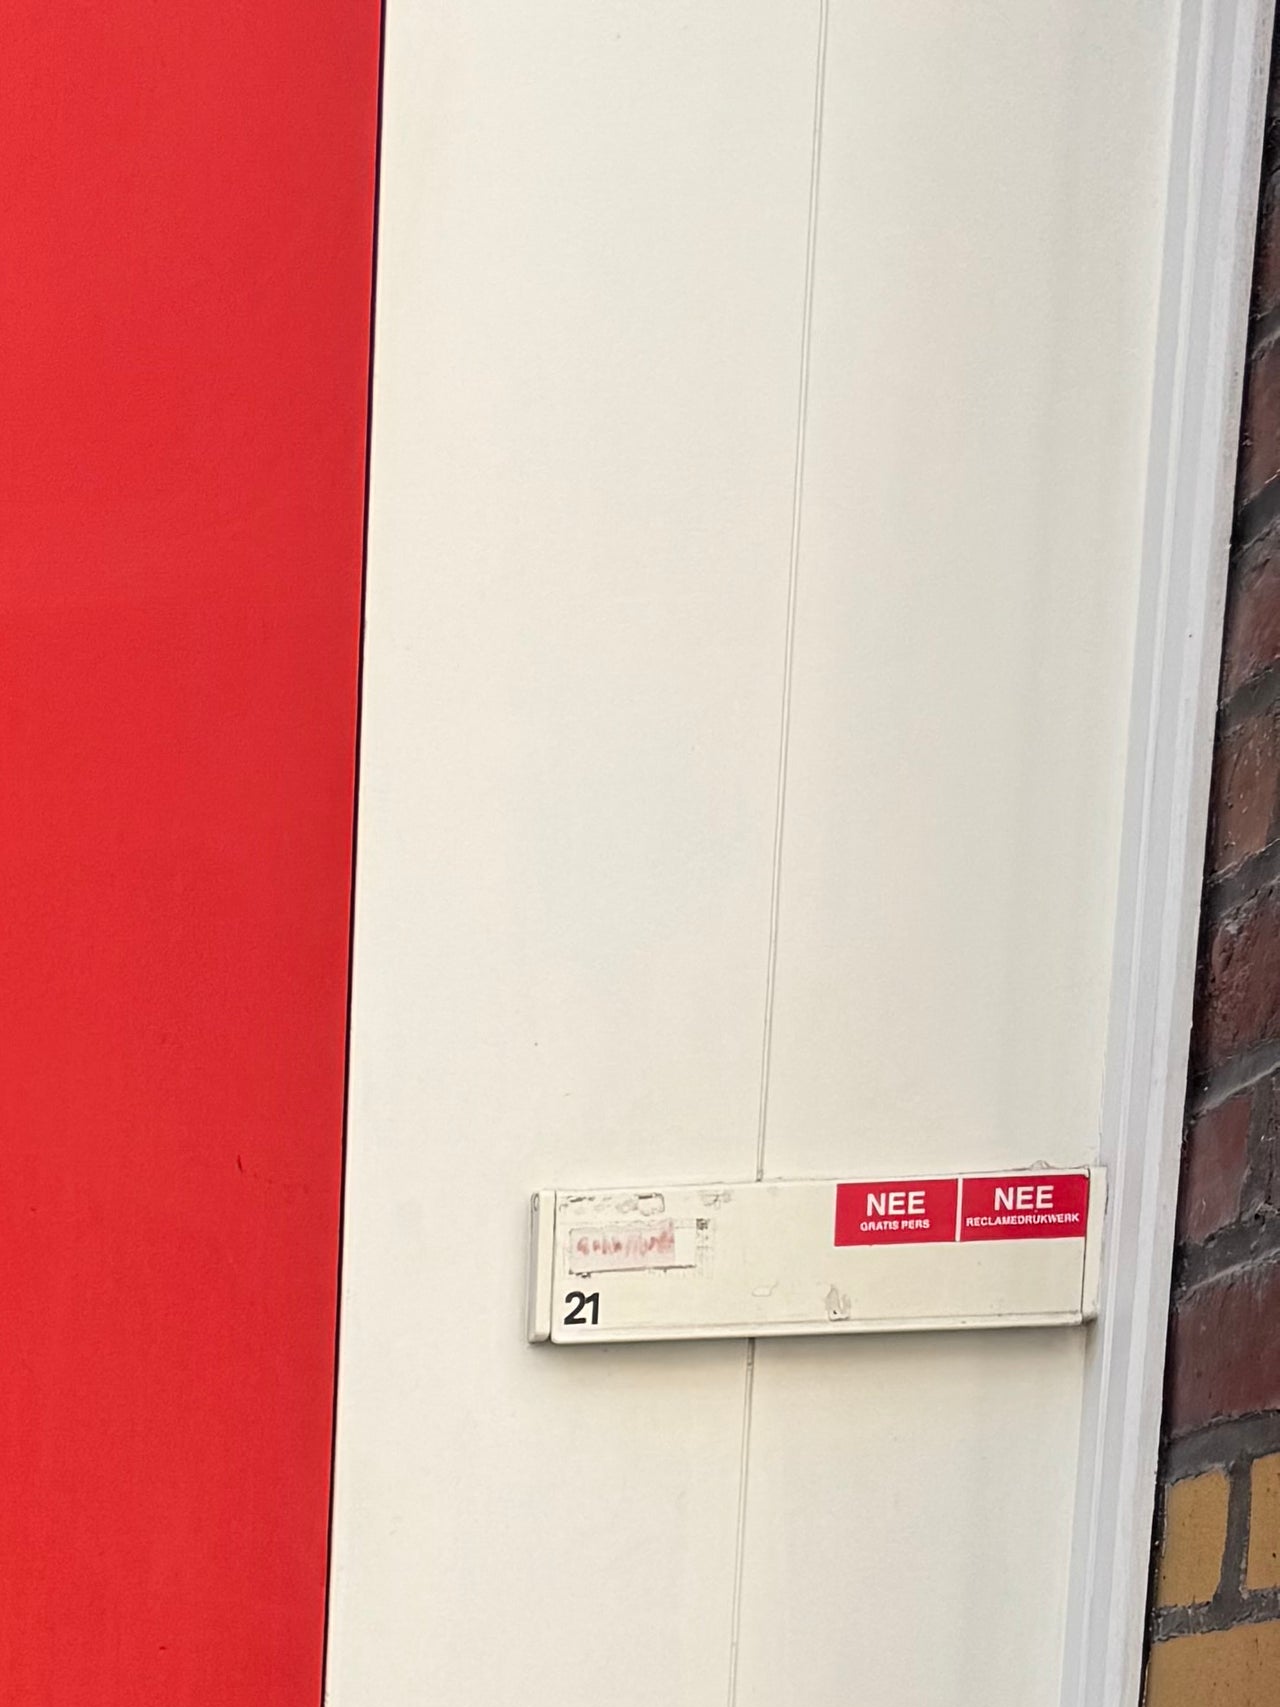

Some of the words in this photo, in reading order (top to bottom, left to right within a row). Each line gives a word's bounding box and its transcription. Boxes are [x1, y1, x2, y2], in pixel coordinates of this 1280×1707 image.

[867, 1191, 926, 1216] NEE
[994, 1185, 1054, 1211] NEE
[859, 1220, 899, 1232] GRATIS
[901, 1219, 930, 1230] PERS
[965, 1213, 1080, 1227] RECLAMEDRUKWERK
[564, 1291, 600, 1325] 21
